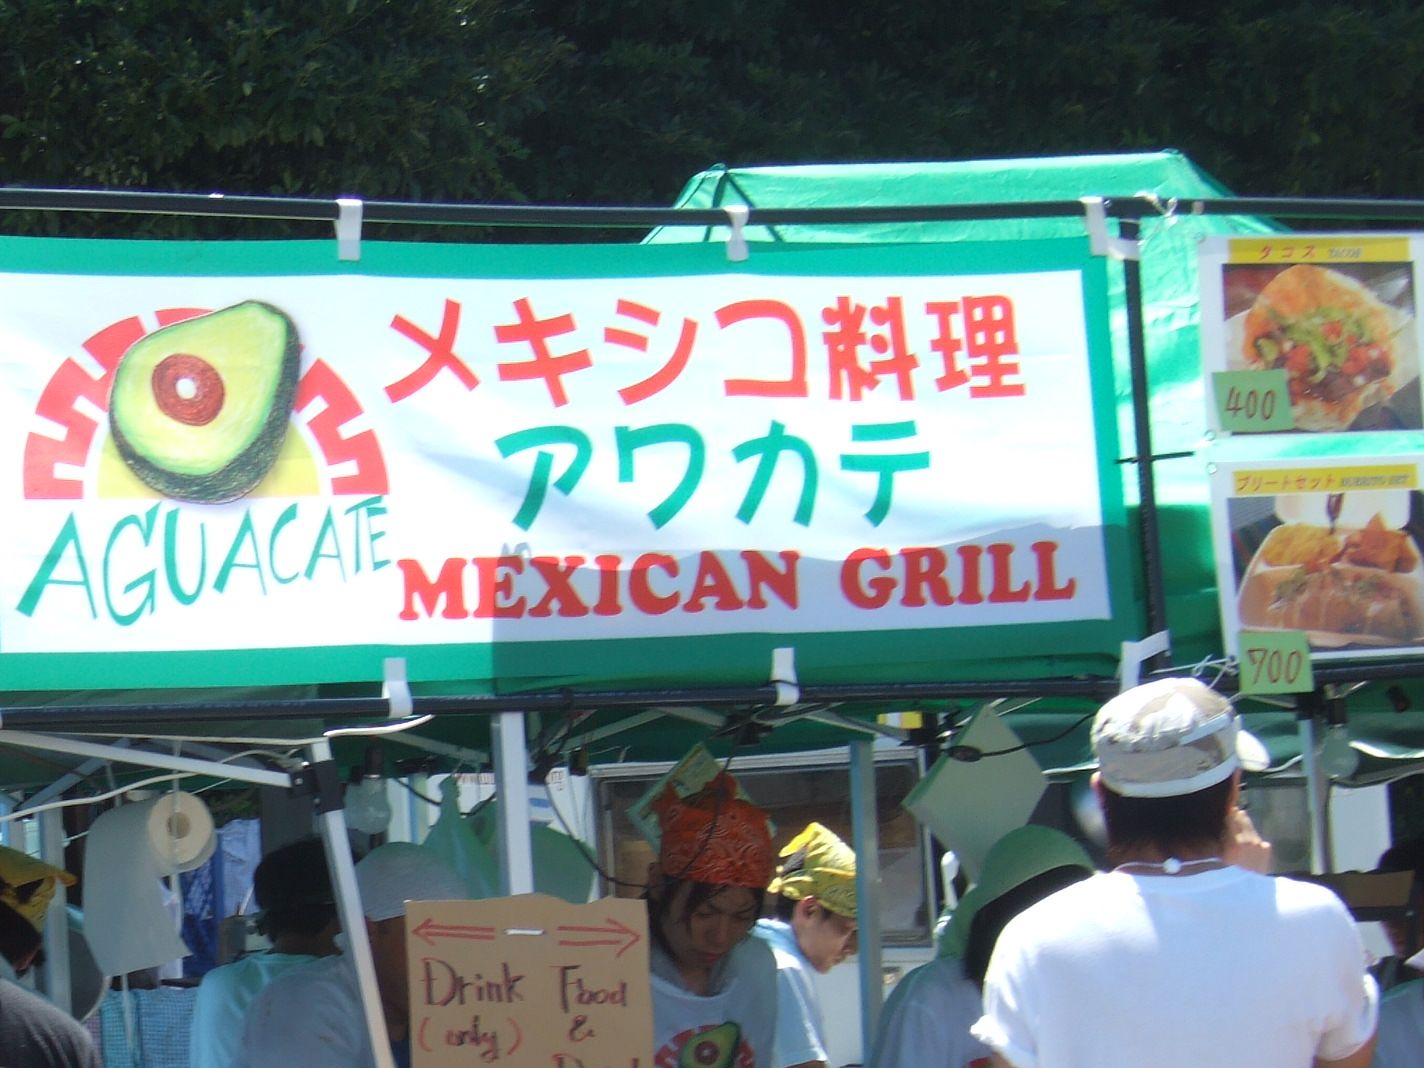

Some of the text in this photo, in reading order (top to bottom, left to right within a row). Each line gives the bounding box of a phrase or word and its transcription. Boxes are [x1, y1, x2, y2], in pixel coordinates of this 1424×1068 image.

[384, 294, 1026, 408] メキシコ料理
[1223, 386, 1276, 421] 400
[495, 420, 931, 532] アワカテ
[16, 495, 391, 627] AGUACATE
[396, 540, 1077, 622] MEXICAN GRILL
[1244, 649, 1303, 686] 700
[420, 956, 525, 1007] Drink
[549, 963, 628, 1013] Food
